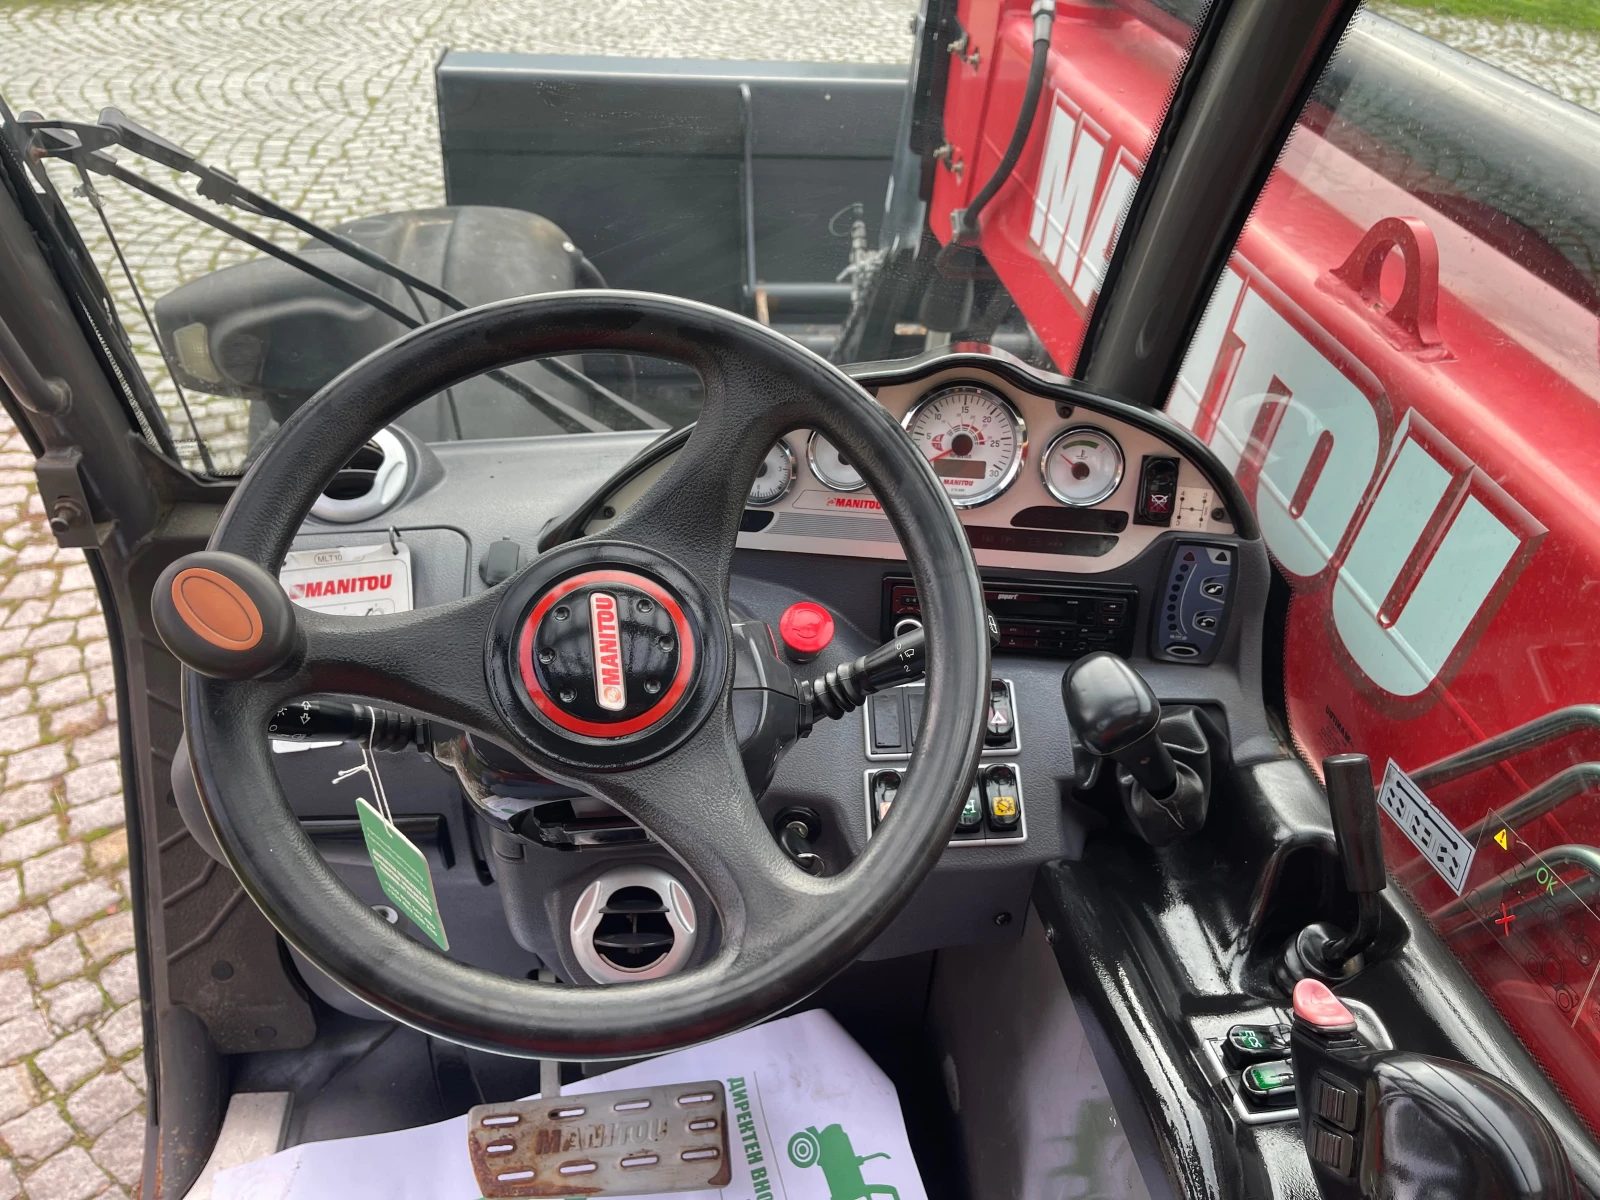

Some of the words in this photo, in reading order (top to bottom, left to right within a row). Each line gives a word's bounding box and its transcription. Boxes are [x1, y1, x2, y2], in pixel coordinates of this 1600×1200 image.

[934, 413, 942, 421] 10
[961, 406, 969, 414] 15
[304, 574, 393, 598] MANITOU
[596, 597, 621, 686] MANITOU
[1536, 867, 1558, 896] OK
[727, 1077, 764, 1165] ДИРЕКТЕН
[535, 1117, 669, 1155] MANITOU
